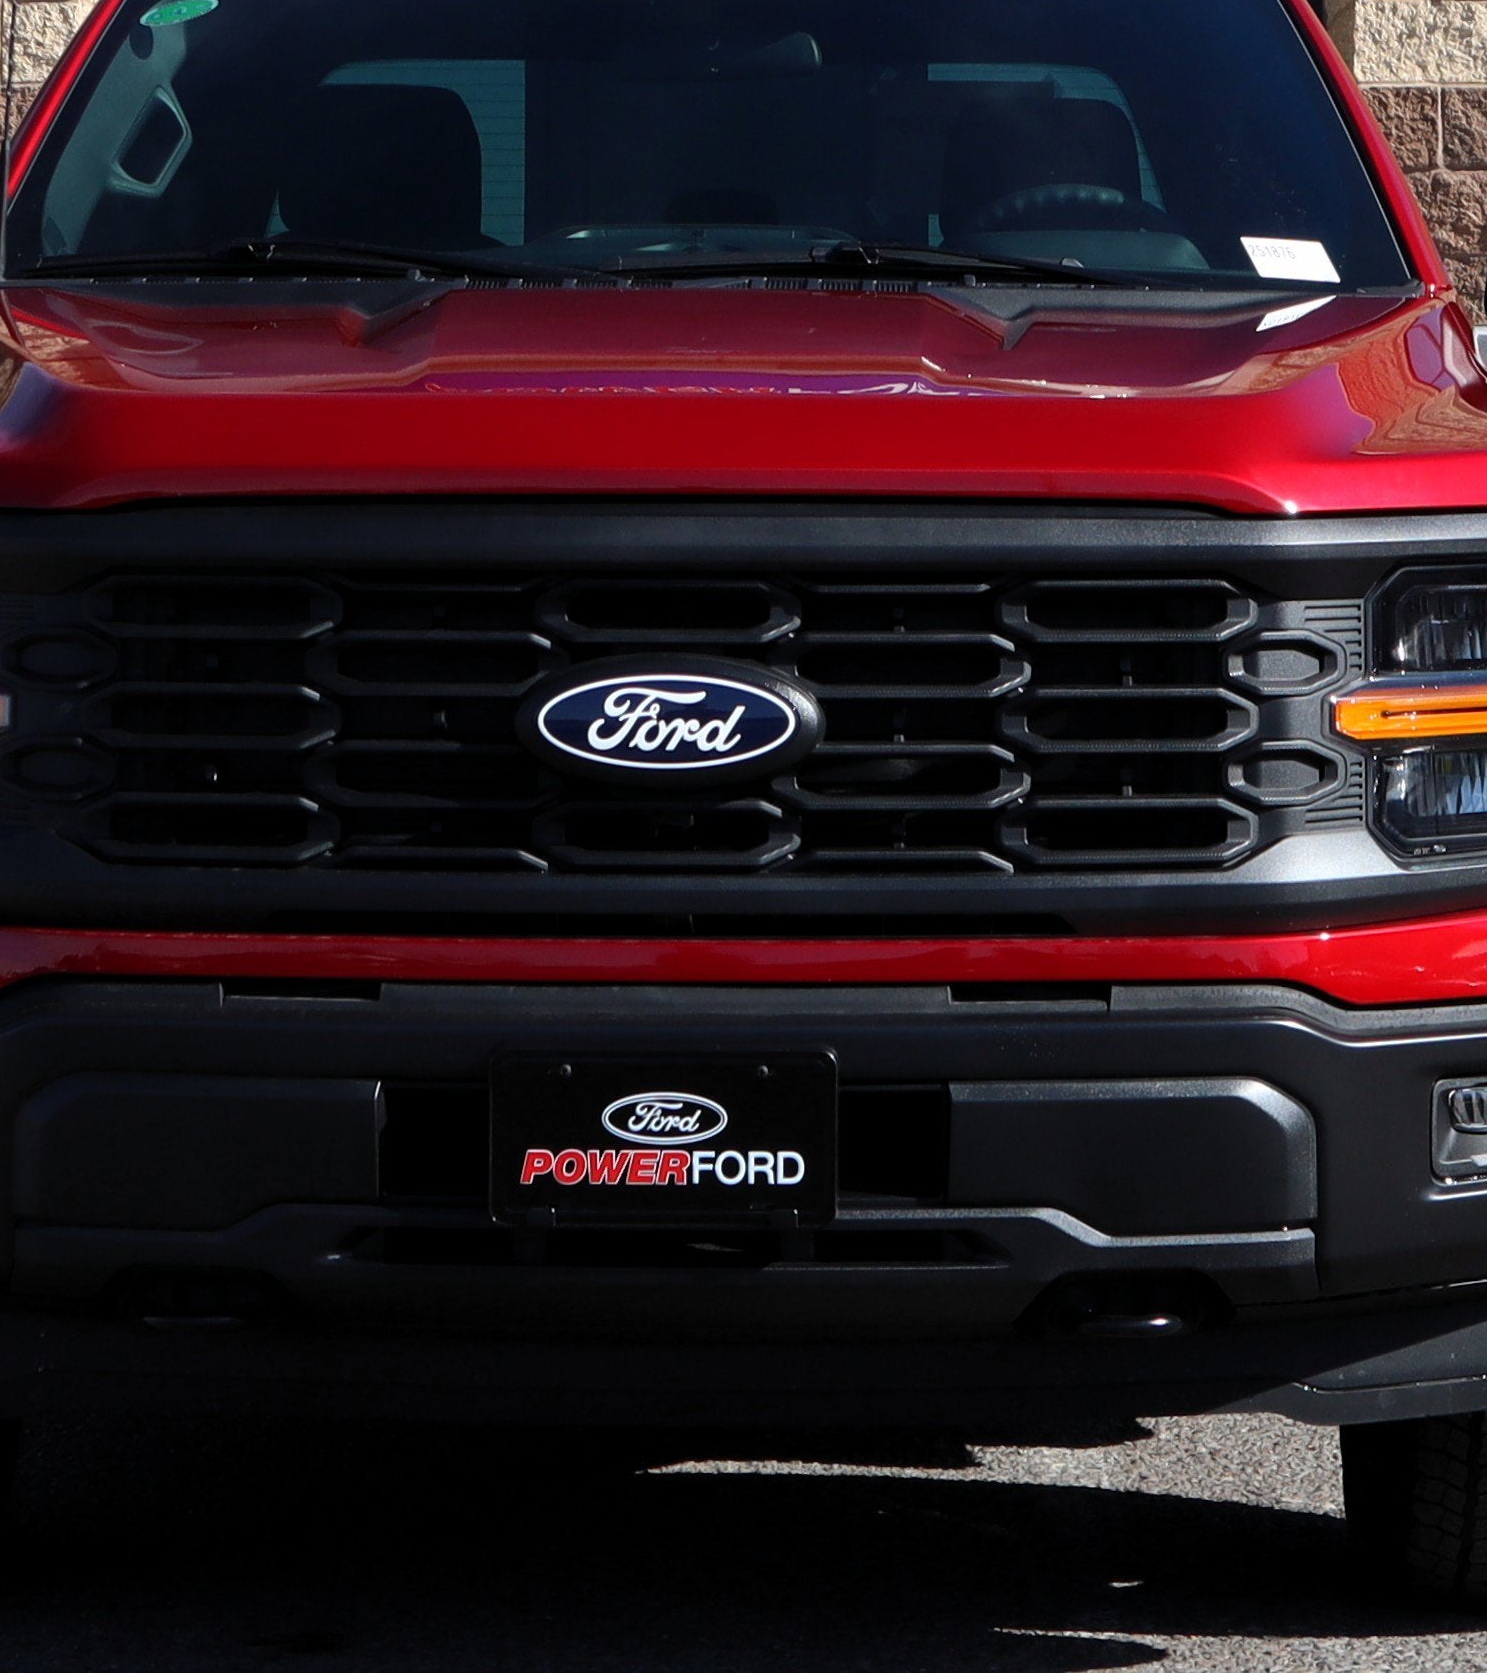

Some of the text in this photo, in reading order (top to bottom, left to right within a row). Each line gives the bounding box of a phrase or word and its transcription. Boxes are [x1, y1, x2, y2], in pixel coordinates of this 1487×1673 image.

[1248, 244, 1296, 260] 251876
[587, 687, 741, 752] Ford
[627, 1102, 702, 1132] Ford
